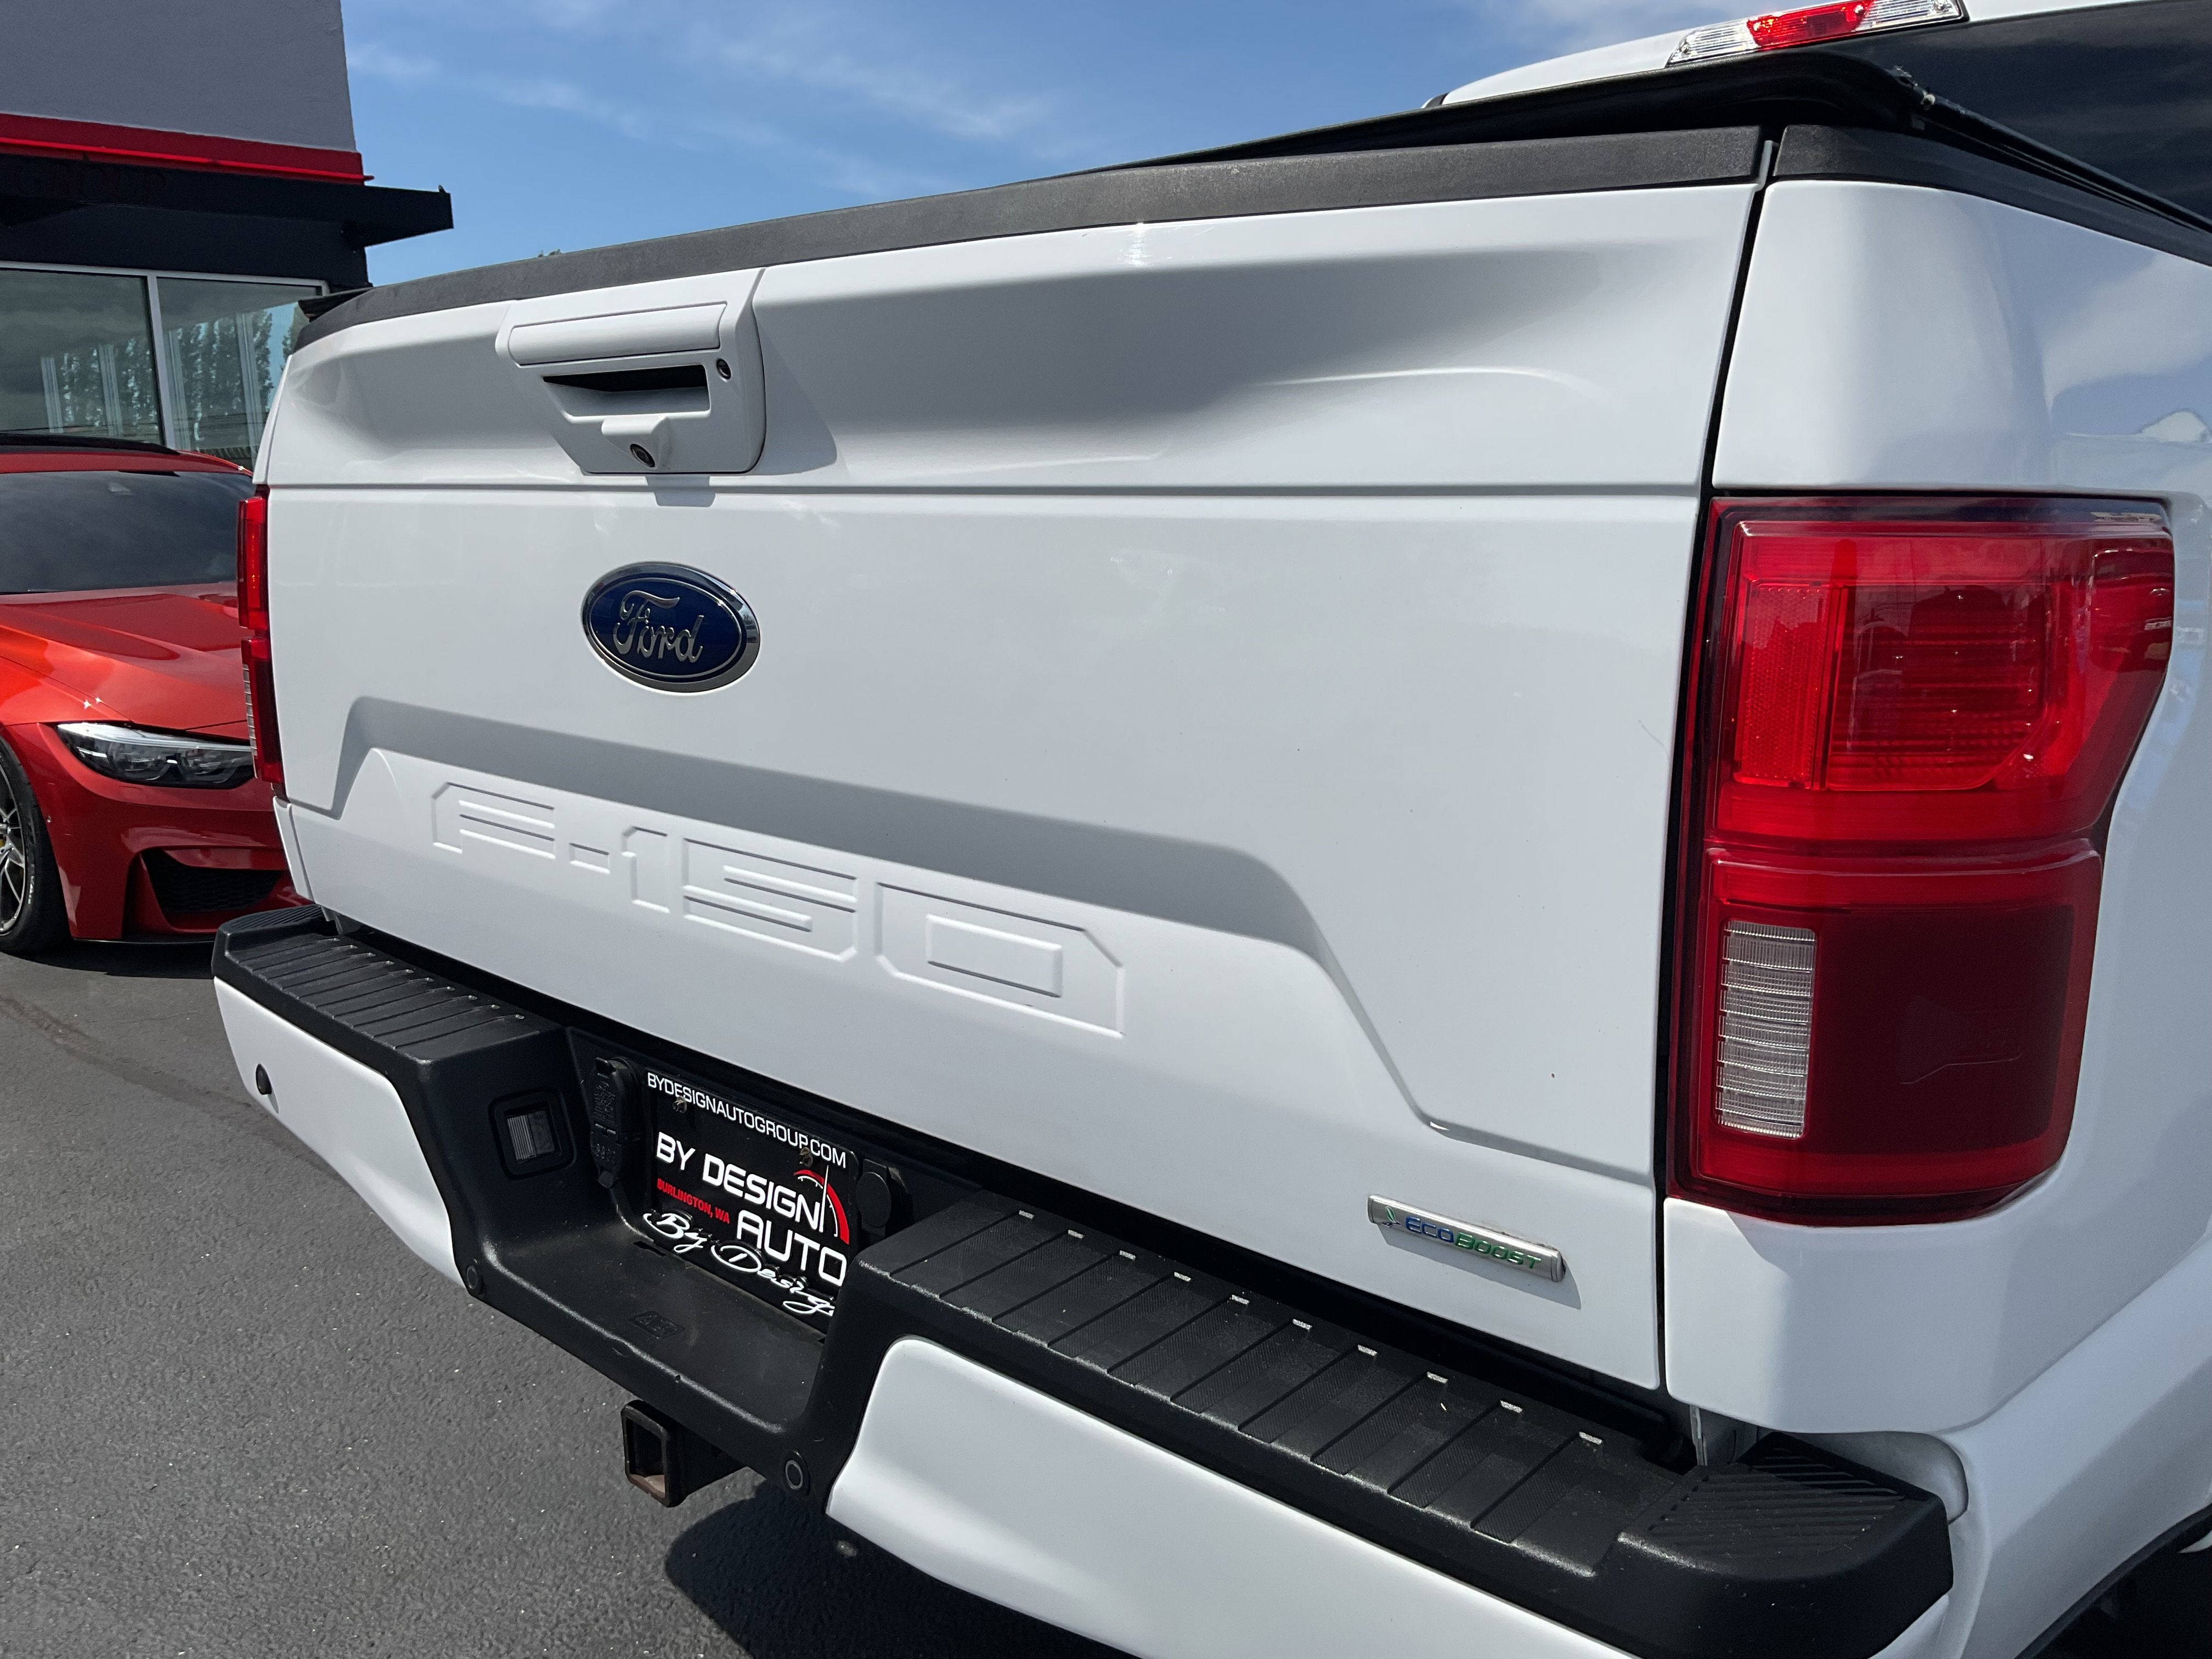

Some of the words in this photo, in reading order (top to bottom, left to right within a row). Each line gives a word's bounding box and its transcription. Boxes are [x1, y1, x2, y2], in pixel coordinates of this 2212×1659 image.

[613, 590, 704, 663] Ford
[432, 782, 1125, 1039] F-150
[647, 1072, 847, 1169] BYDESIGNAUTOGROUPCOM
[656, 1131, 696, 1171] BY
[703, 1153, 820, 1231] DESIGN
[657, 1177, 713, 1218] BURLINGTON,
[715, 1207, 730, 1224] WA
[643, 1211, 708, 1254] By
[711, 1244, 836, 1317] Desig
[736, 1210, 847, 1286] AUTO
